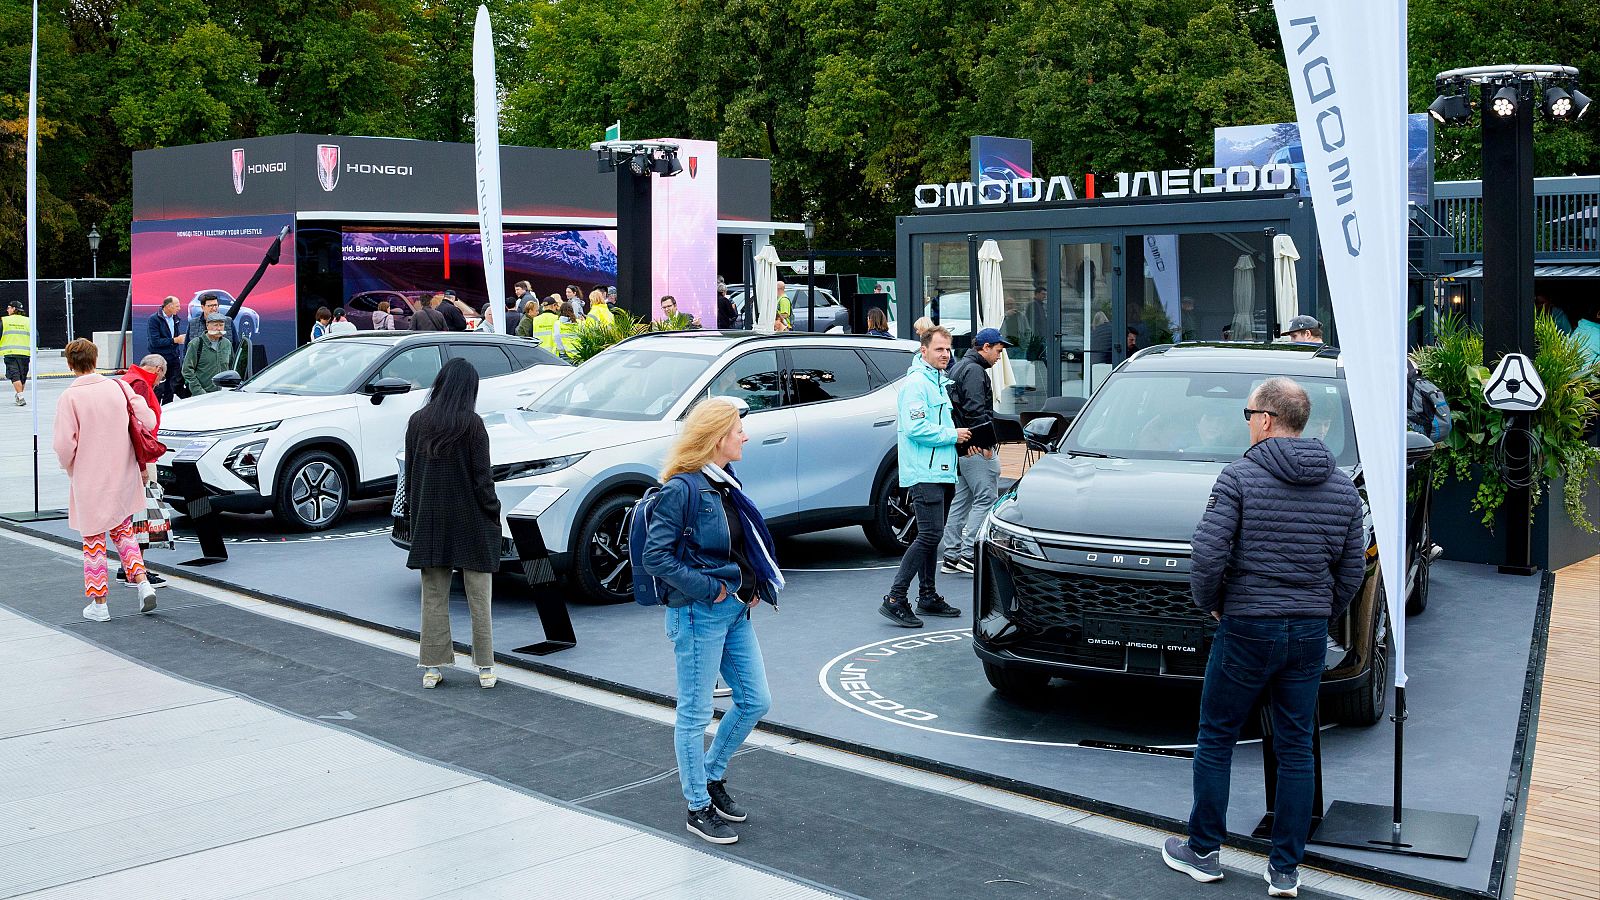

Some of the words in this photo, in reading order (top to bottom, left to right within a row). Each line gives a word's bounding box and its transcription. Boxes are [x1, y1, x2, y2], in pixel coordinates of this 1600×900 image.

[248, 162, 287, 174] HONGQI
[346, 163, 413, 176] HONGQI
[914, 176, 1075, 208] OMODA
[1102, 164, 1292, 198] JAECOO
[1086, 553, 1178, 567] OMOD
[1087, 638, 1121, 646] OMODA
[1125, 641, 1158, 649] JAECOO
[839, 662, 939, 721] JAECOO
